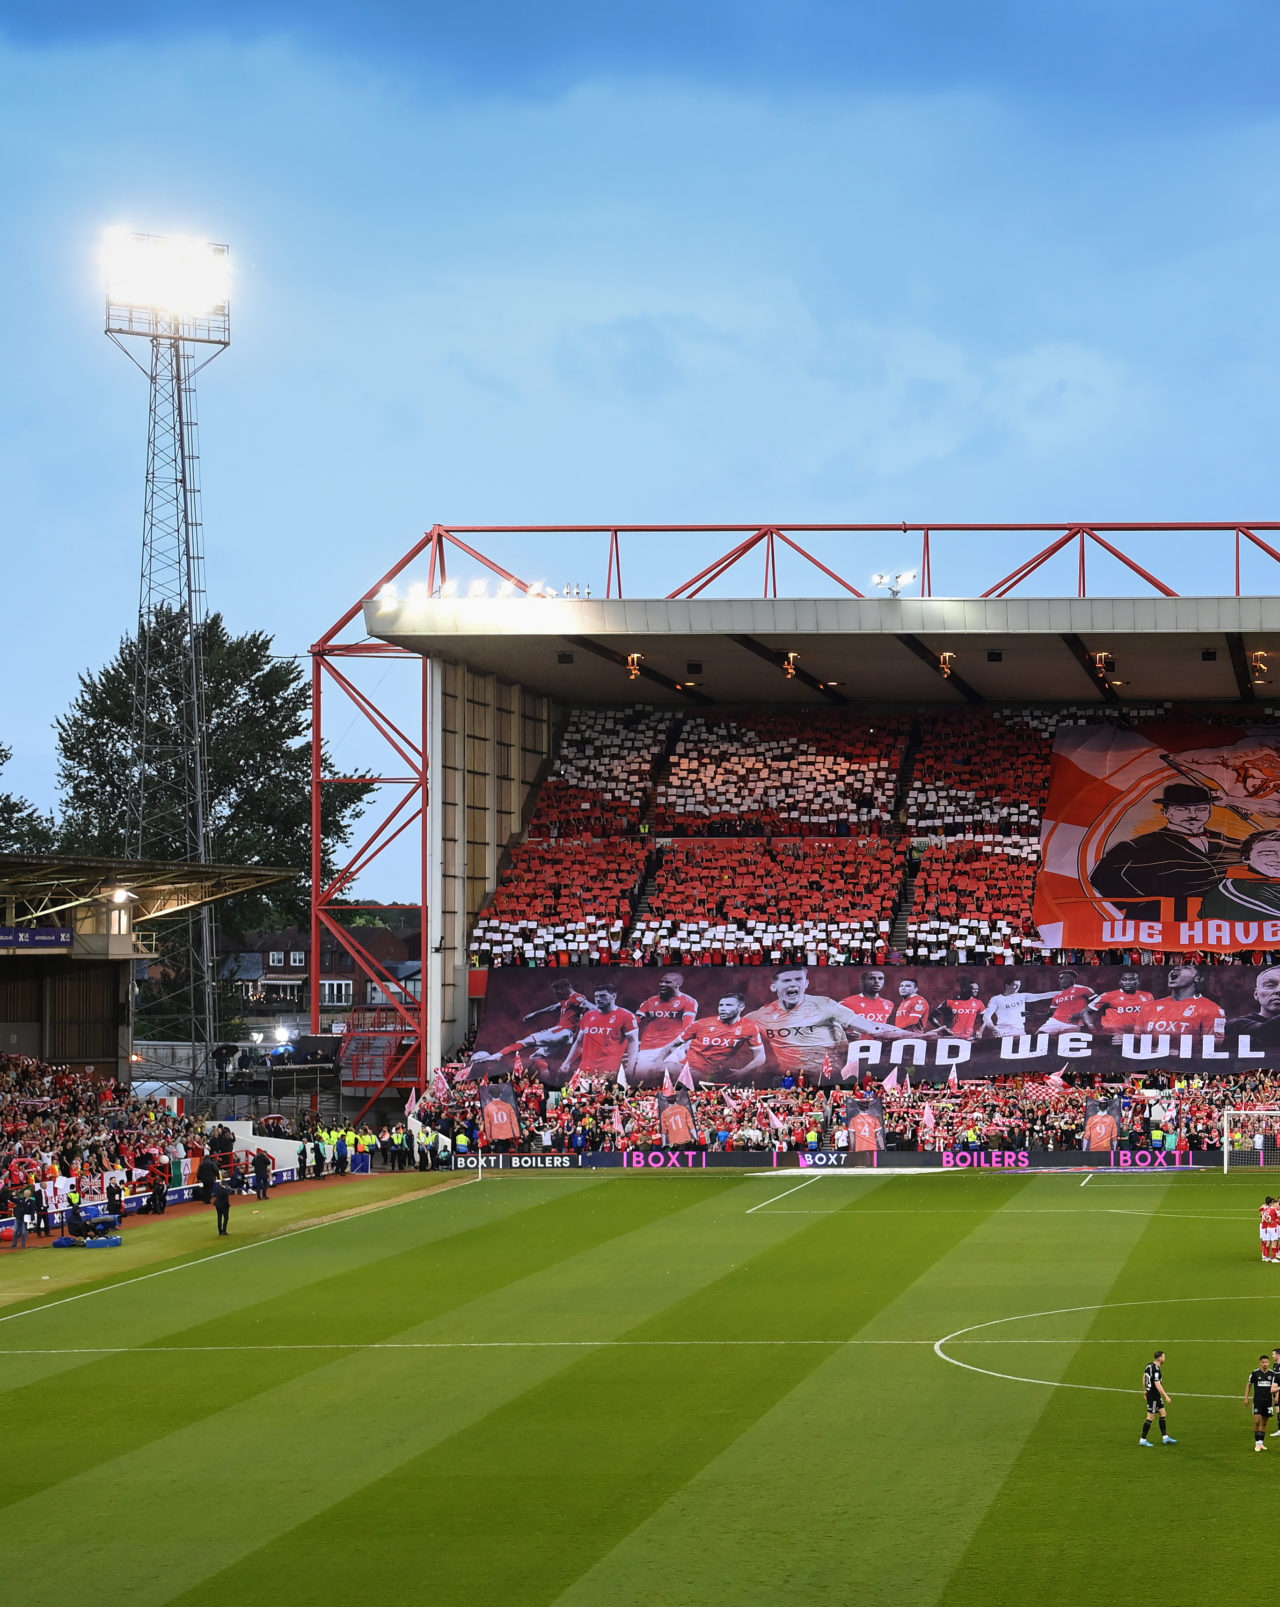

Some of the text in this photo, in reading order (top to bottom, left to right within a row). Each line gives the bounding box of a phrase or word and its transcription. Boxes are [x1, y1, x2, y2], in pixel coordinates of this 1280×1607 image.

[1102, 920, 1163, 942] WE
[1117, 1005, 1142, 1014] BOX
[584, 1026, 613, 1036] BOXT
[765, 1024, 817, 1039] BOXT
[1147, 1020, 1190, 1033] BOXT
[702, 1036, 741, 1048] BOXT
[847, 1038, 972, 1066] AND
[1000, 1032, 1093, 1060] WE
[1121, 1033, 1265, 1060] WILL
[492, 1111, 507, 1124] 10
[669, 1114, 684, 1130] 11
[860, 1123, 871, 1138] 4
[1095, 1123, 1106, 1138] 9
[457, 1155, 570, 1168] BOXT BOILERS
[632, 1151, 697, 1168] BOXT
[804, 1153, 848, 1167] BOXT
[942, 1151, 1030, 1168] BOILERS
[1119, 1150, 1183, 1167] BOXT
